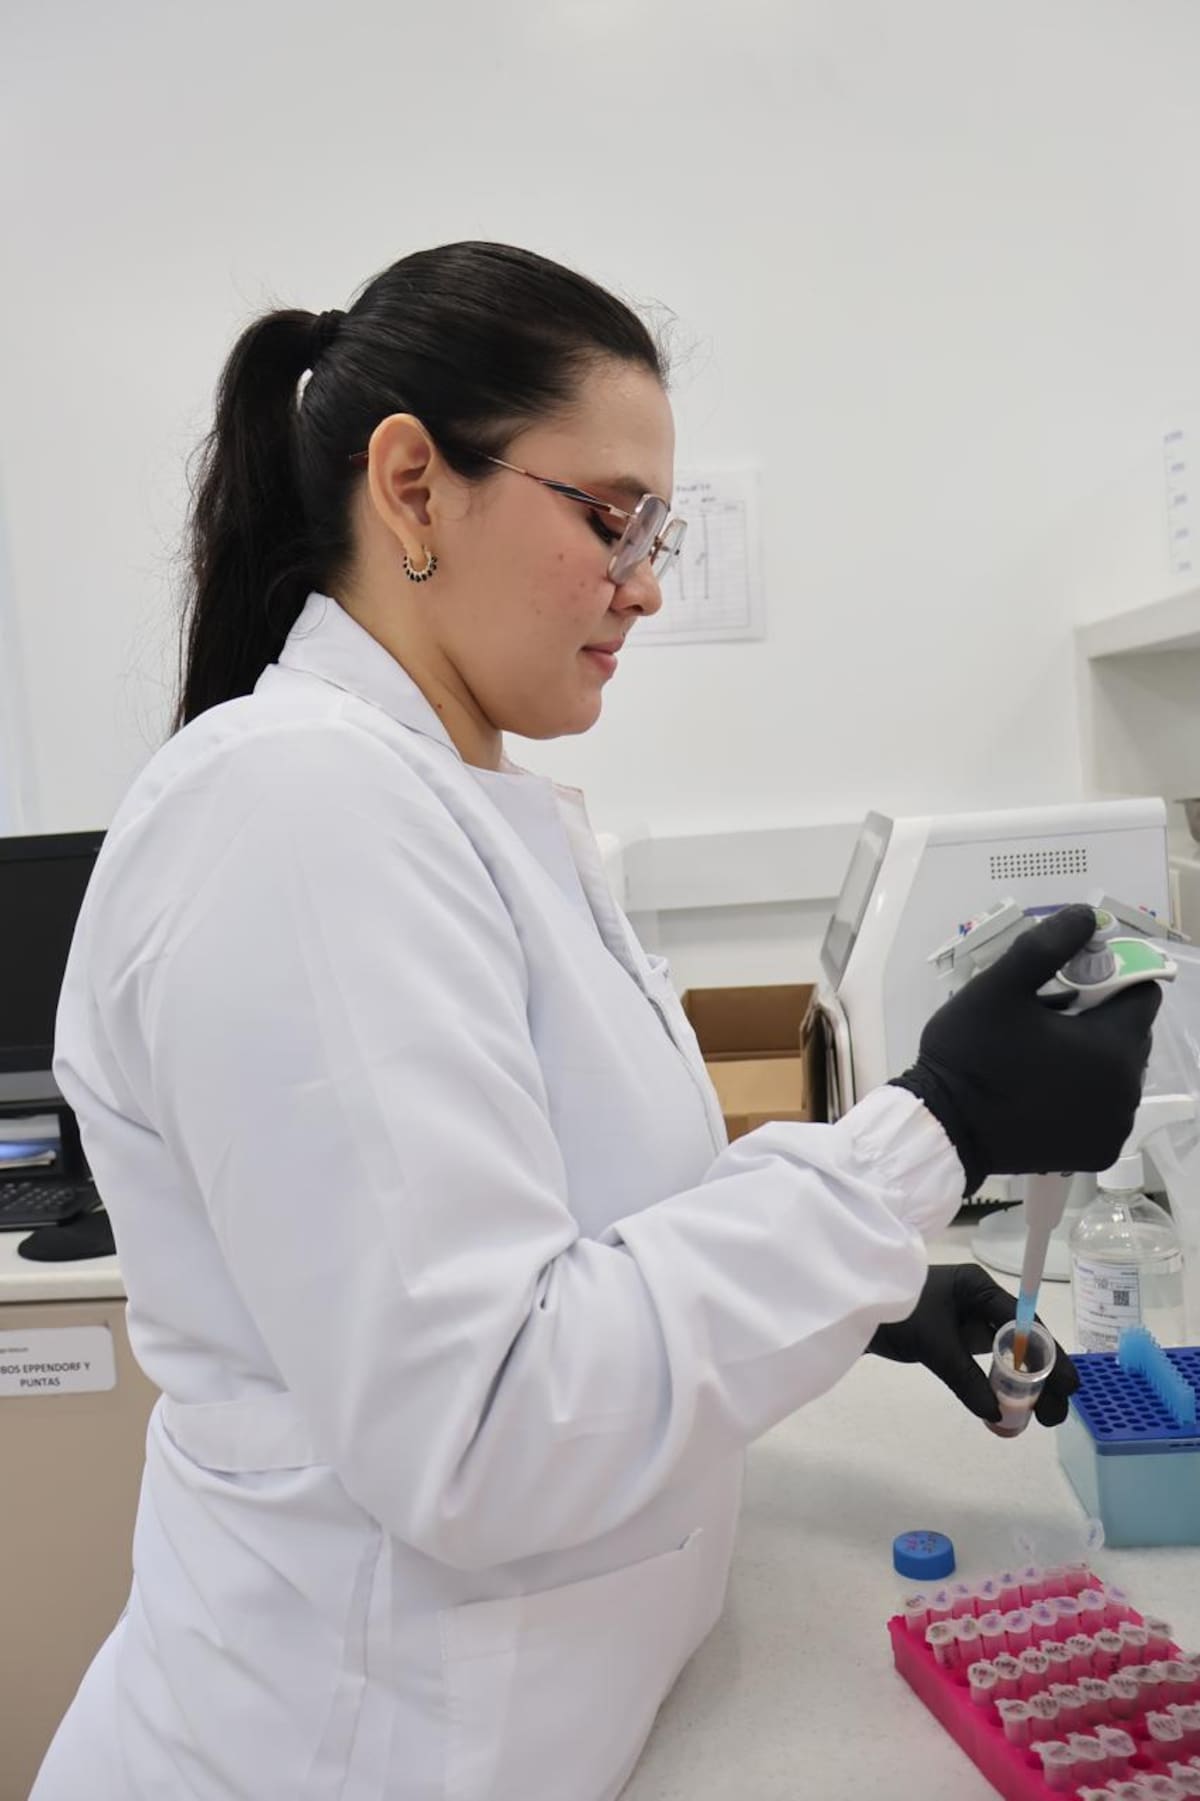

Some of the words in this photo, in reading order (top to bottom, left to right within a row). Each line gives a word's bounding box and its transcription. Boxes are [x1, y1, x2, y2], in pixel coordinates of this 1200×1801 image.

[23, 1362, 81, 1374] EPPENDORF
[84, 1362, 90, 1371] Y
[20, 1377, 60, 1387] PUNTAS
